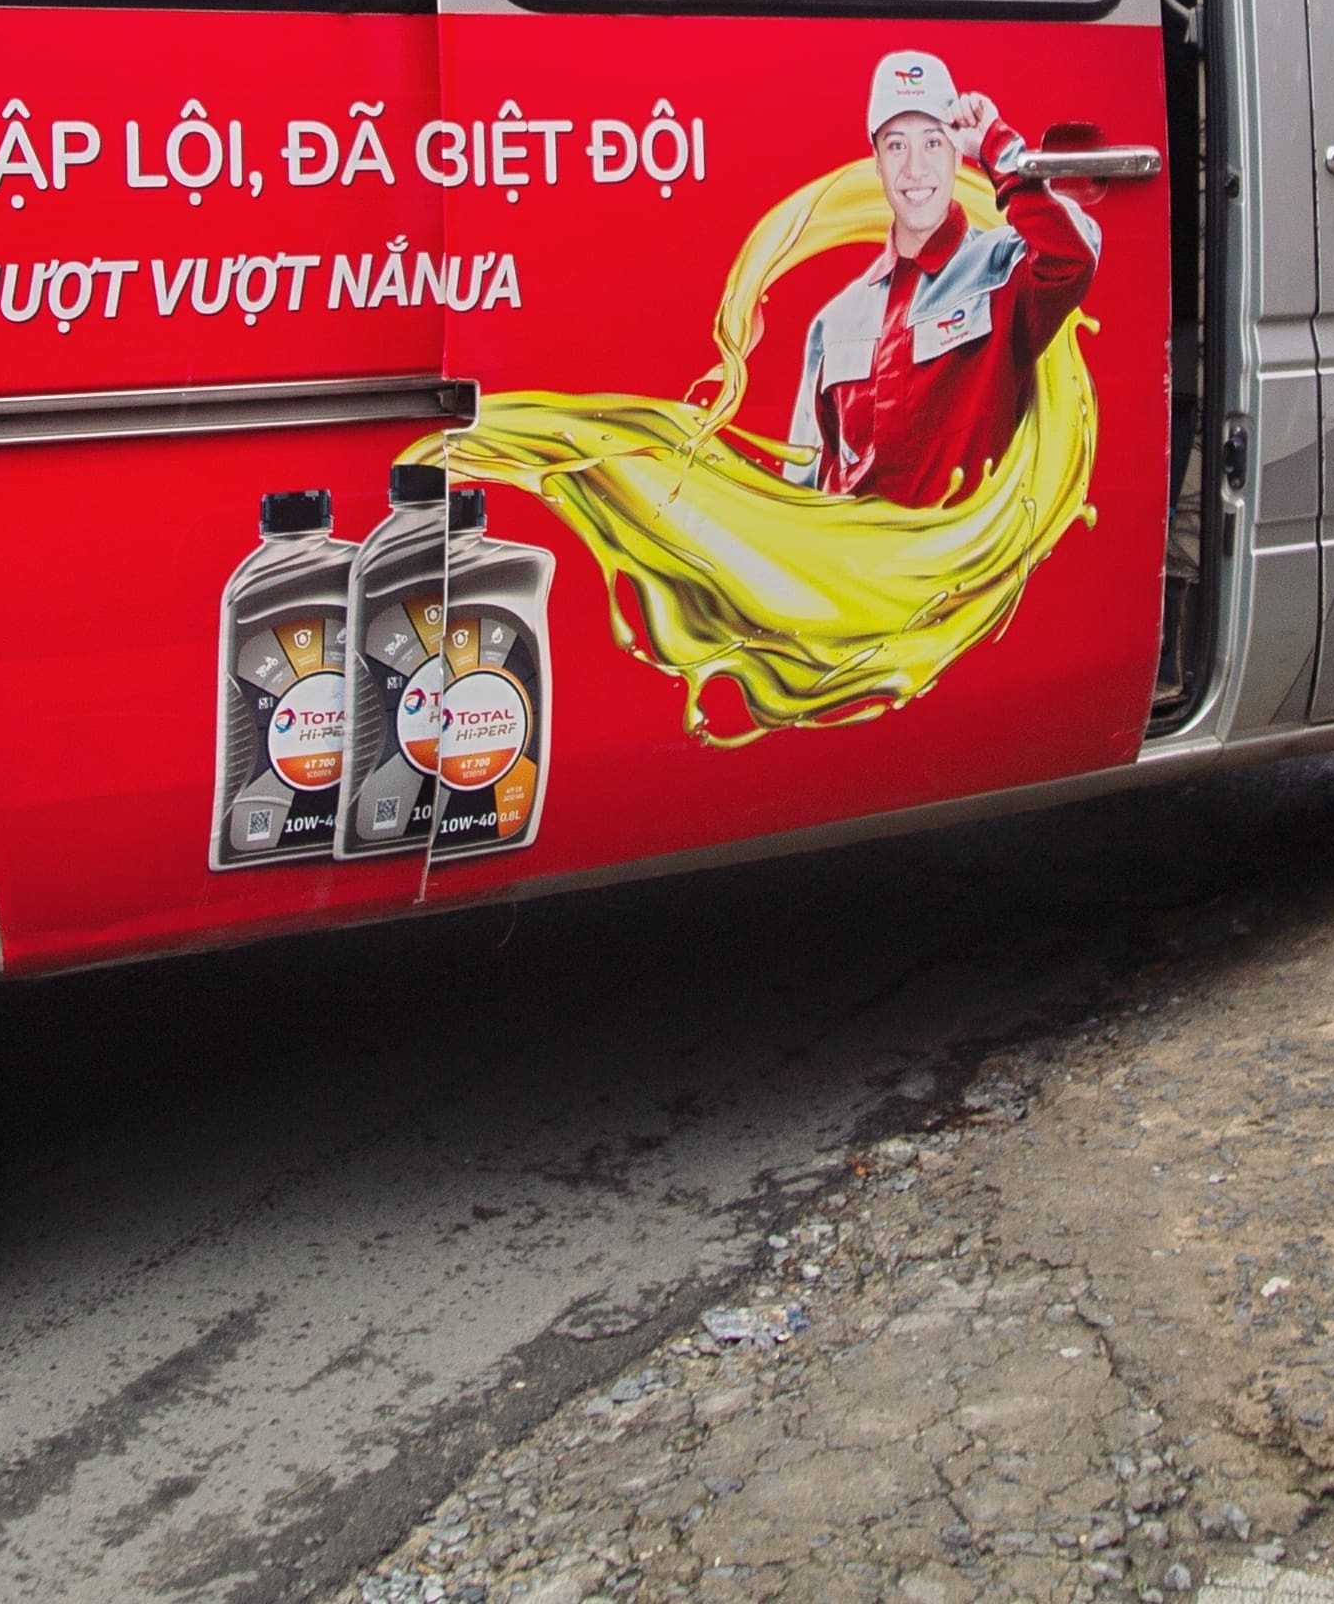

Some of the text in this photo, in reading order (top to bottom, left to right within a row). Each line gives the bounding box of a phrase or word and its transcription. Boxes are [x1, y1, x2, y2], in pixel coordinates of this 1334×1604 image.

[125, 98, 264, 206] LỘI,
[281, 100, 395, 187] ĐÃ
[585, 98, 705, 199] ĐỘI
[150, 253, 320, 326] VƯỢT
[456, 708, 515, 725] TOTAL
[456, 722, 517, 741] Hi-PERF
[460, 757, 491, 770] 4T 700
[440, 812, 497, 834] 10W-40
